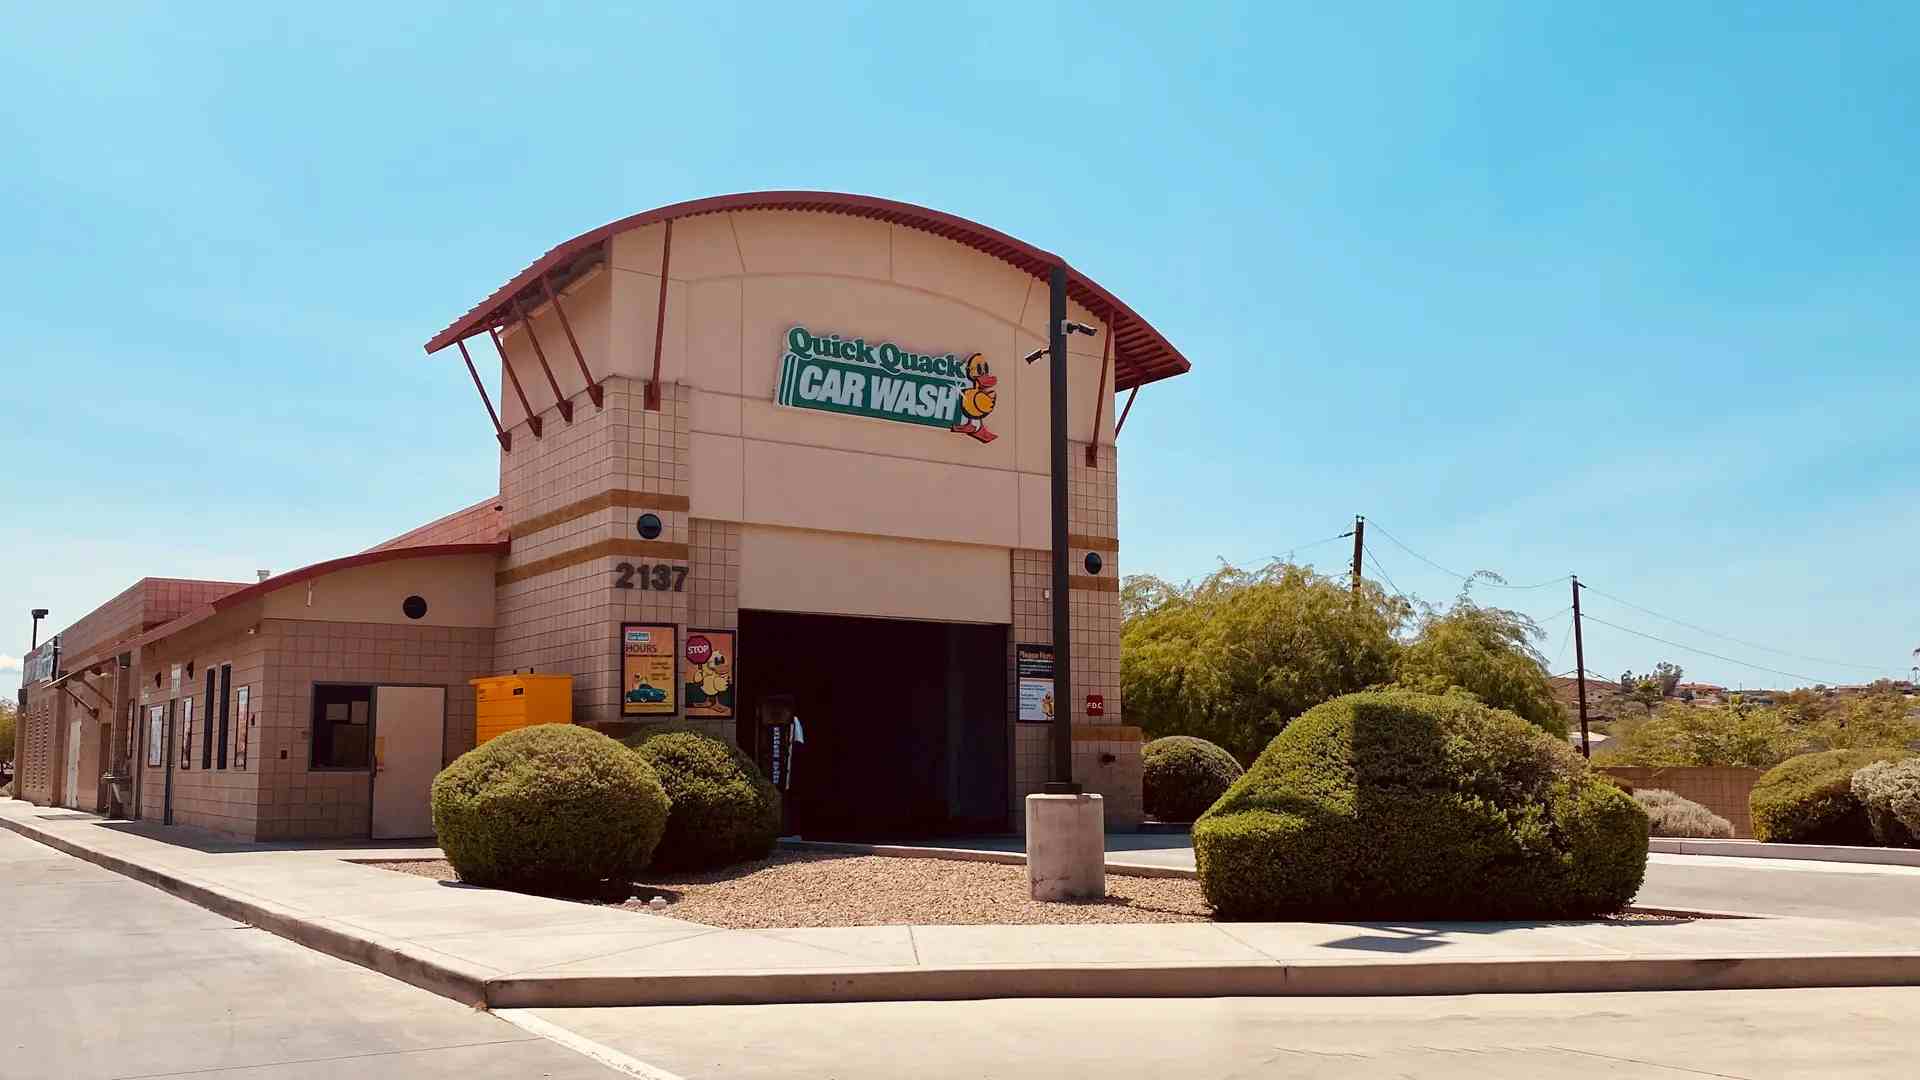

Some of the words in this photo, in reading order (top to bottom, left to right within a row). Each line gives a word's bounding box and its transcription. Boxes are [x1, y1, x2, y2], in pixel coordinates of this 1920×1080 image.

[789, 327, 874, 360] Quick
[879, 343, 966, 378] Quack
[799, 364, 866, 408] CAR
[870, 376, 957, 420] WASH
[616, 562, 689, 592] 2137
[625, 643, 657, 654] HOURS
[687, 643, 710, 655] STOP
